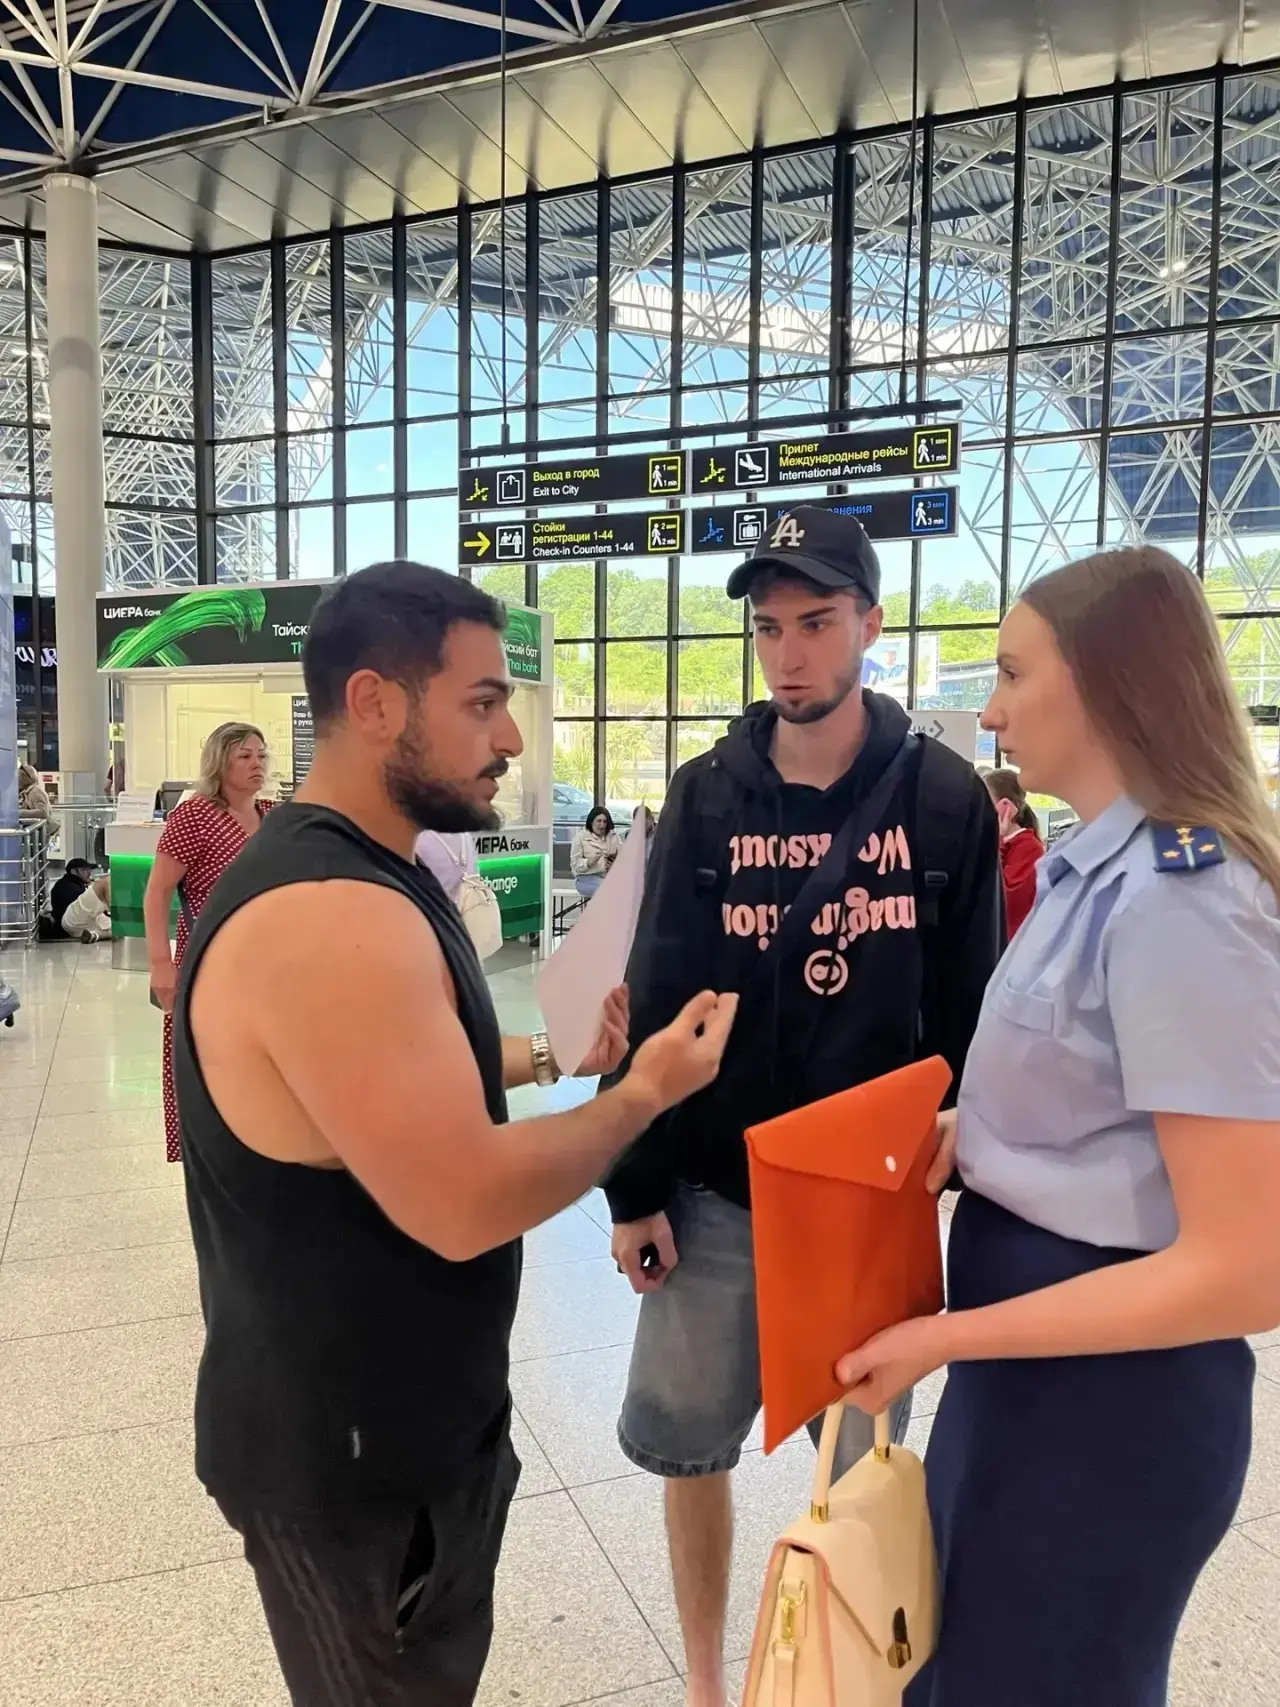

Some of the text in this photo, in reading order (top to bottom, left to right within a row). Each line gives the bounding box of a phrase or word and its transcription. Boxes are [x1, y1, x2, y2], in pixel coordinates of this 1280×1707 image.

[779, 443, 819, 456] Прилет
[779, 446, 908, 467] Международные рейсы
[533, 468, 599, 482] Выход в город
[779, 462, 882, 481] International Arrivals
[533, 484, 580, 498] Exit to City
[827, 504, 872, 515] анения
[533, 522, 566, 533] Стойки
[533, 529, 613, 546] регистрации 1-44
[533, 542, 634, 557] Check-in Counters 1-44
[144, 608, 162, 617] банк
[272, 621, 310, 637] Тайск
[504, 639, 538, 658] йский бат
[507, 658, 539, 674] Thai baht
[510, 838, 530, 851] банк
[729, 825, 911, 875] Woksout
